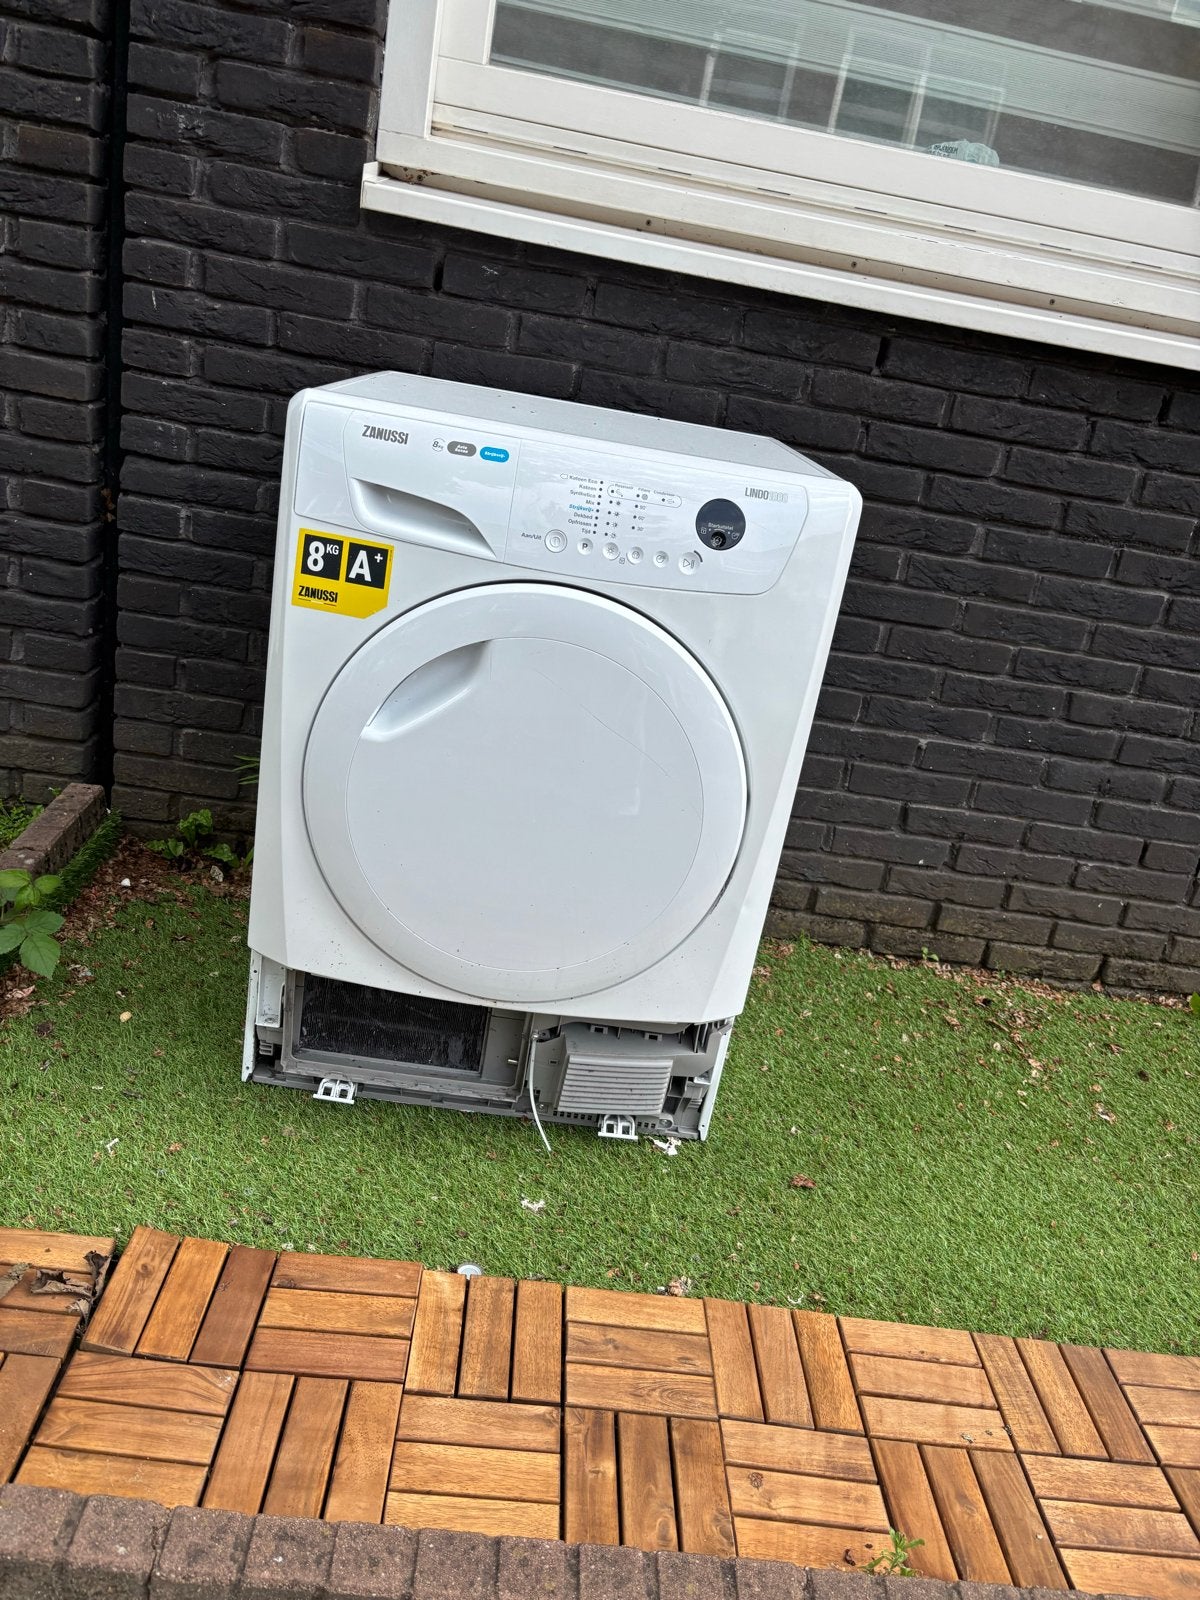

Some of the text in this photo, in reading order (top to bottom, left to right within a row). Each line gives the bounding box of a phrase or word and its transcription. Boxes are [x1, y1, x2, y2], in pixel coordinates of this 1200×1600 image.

[361, 424, 409, 445] ZANUSSI
[569, 475, 587, 483] Katoen
[573, 511, 593, 520] Dekbed
[567, 518, 592, 527] Opfrissen
[521, 531, 542, 541] Aan/Uit
[298, 585, 339, 604] ZANUSSI
